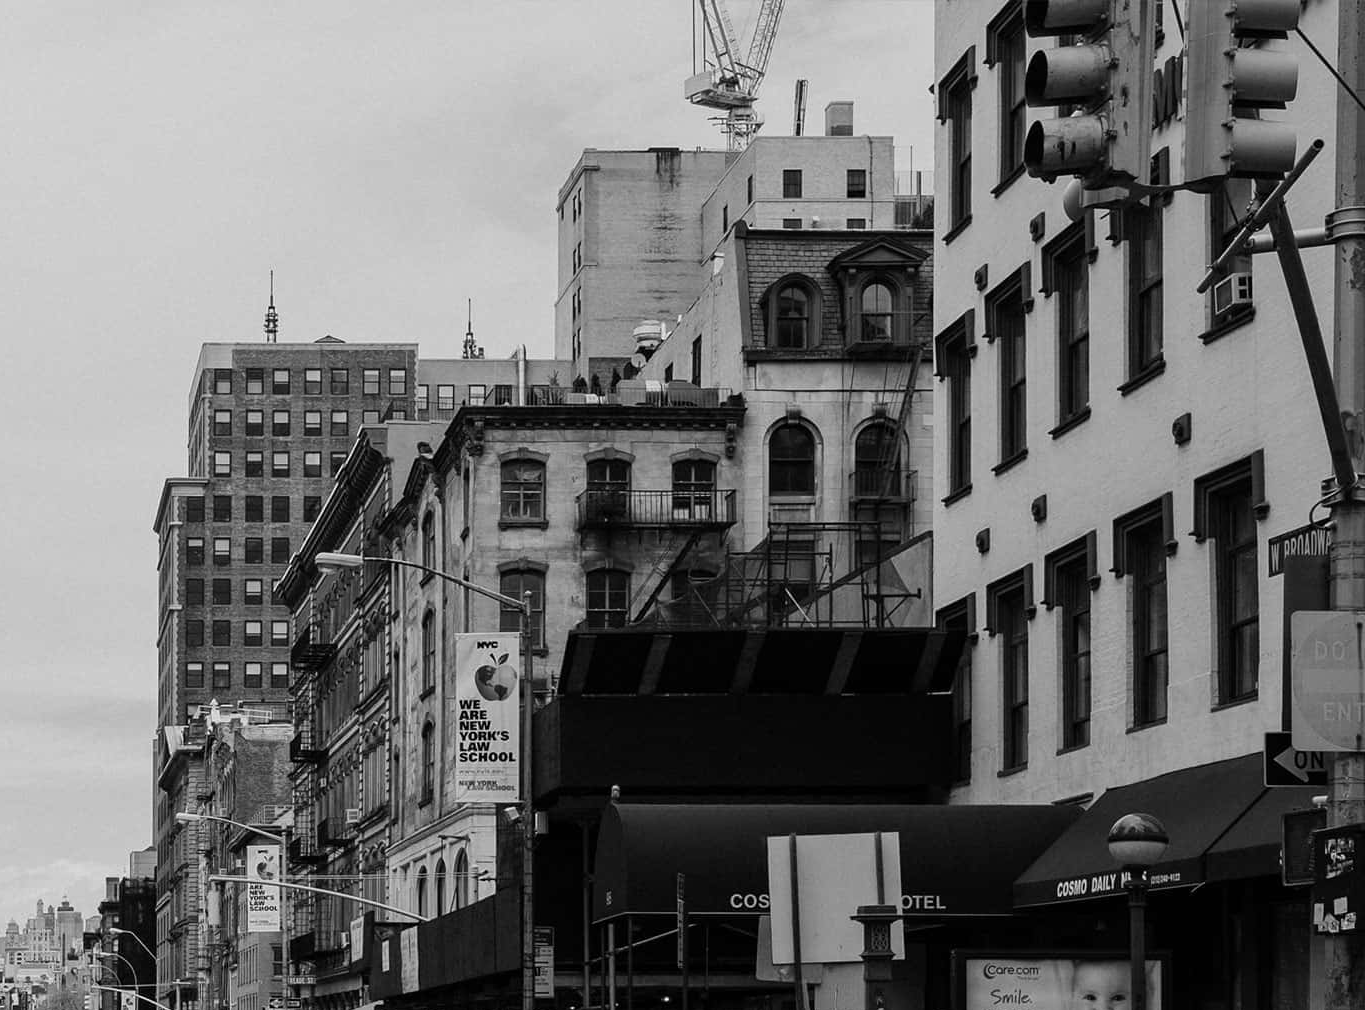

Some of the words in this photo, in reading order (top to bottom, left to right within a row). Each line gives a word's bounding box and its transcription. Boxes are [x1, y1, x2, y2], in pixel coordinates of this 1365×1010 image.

[1270, 542, 1280, 572] W
[1284, 527, 1331, 557] BROADWA
[1315, 640, 1346, 661] DO
[459, 700, 480, 709] WE
[1323, 702, 1365, 721] ENT
[459, 711, 487, 720] ARE
[459, 721, 491, 730] NEW
[460, 731, 509, 741] YORK'S
[459, 743, 490, 751] LAW
[459, 753, 516, 762] SCHOOL
[1294, 751, 1325, 769] ON
[1056, 878, 1088, 897] COSMO
[1091, 873, 1116, 893] DAILY
[901, 894, 947, 910] OTEL
[984, 964, 1039, 979] Care.com
[990, 989, 1033, 1005] Smile.
